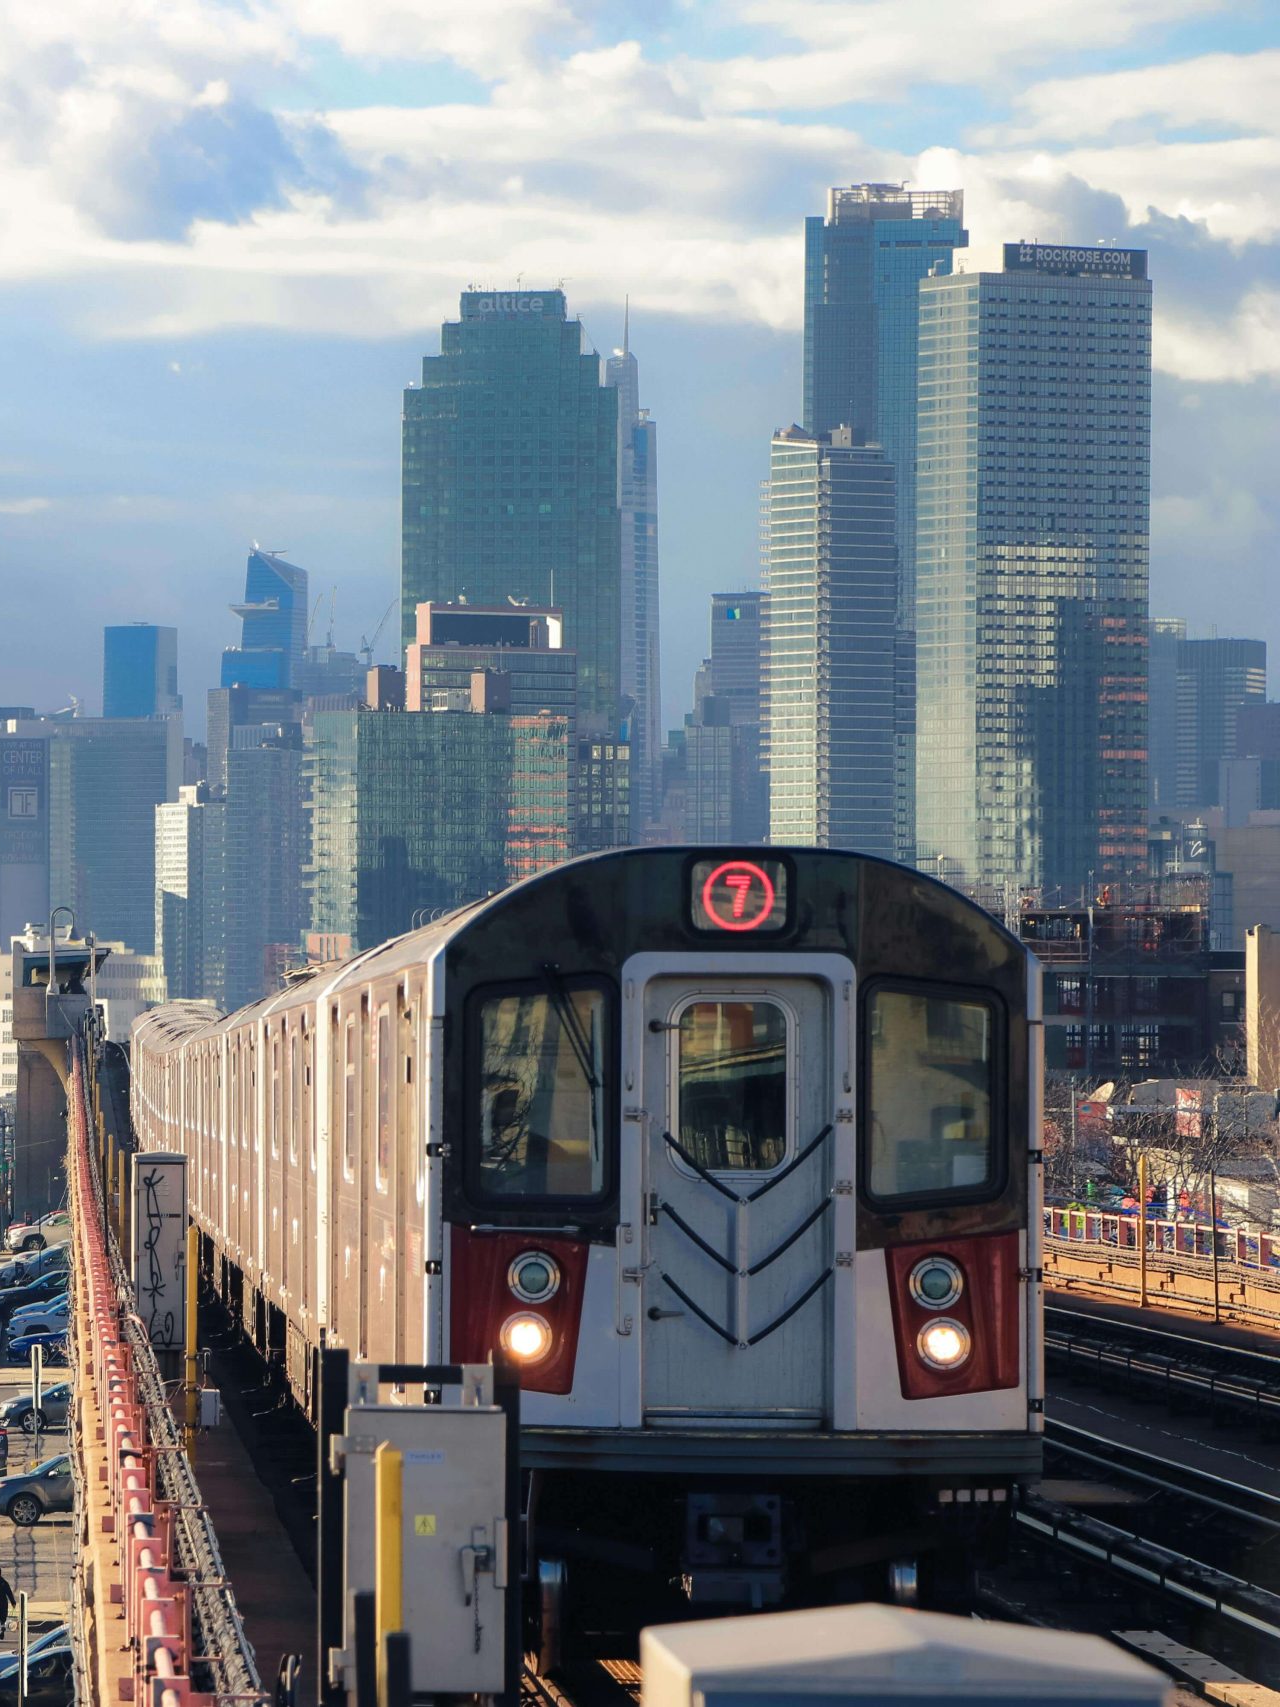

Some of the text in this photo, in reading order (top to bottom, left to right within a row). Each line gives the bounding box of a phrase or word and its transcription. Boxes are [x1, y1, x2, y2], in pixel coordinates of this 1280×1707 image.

[1036, 249, 1131, 265] ROCKROSE.COM
[1084, 264, 1131, 272] RENTALS
[479, 293, 544, 313] altice
[3, 750, 43, 764] CENTER
[726, 875, 751, 918] 7
